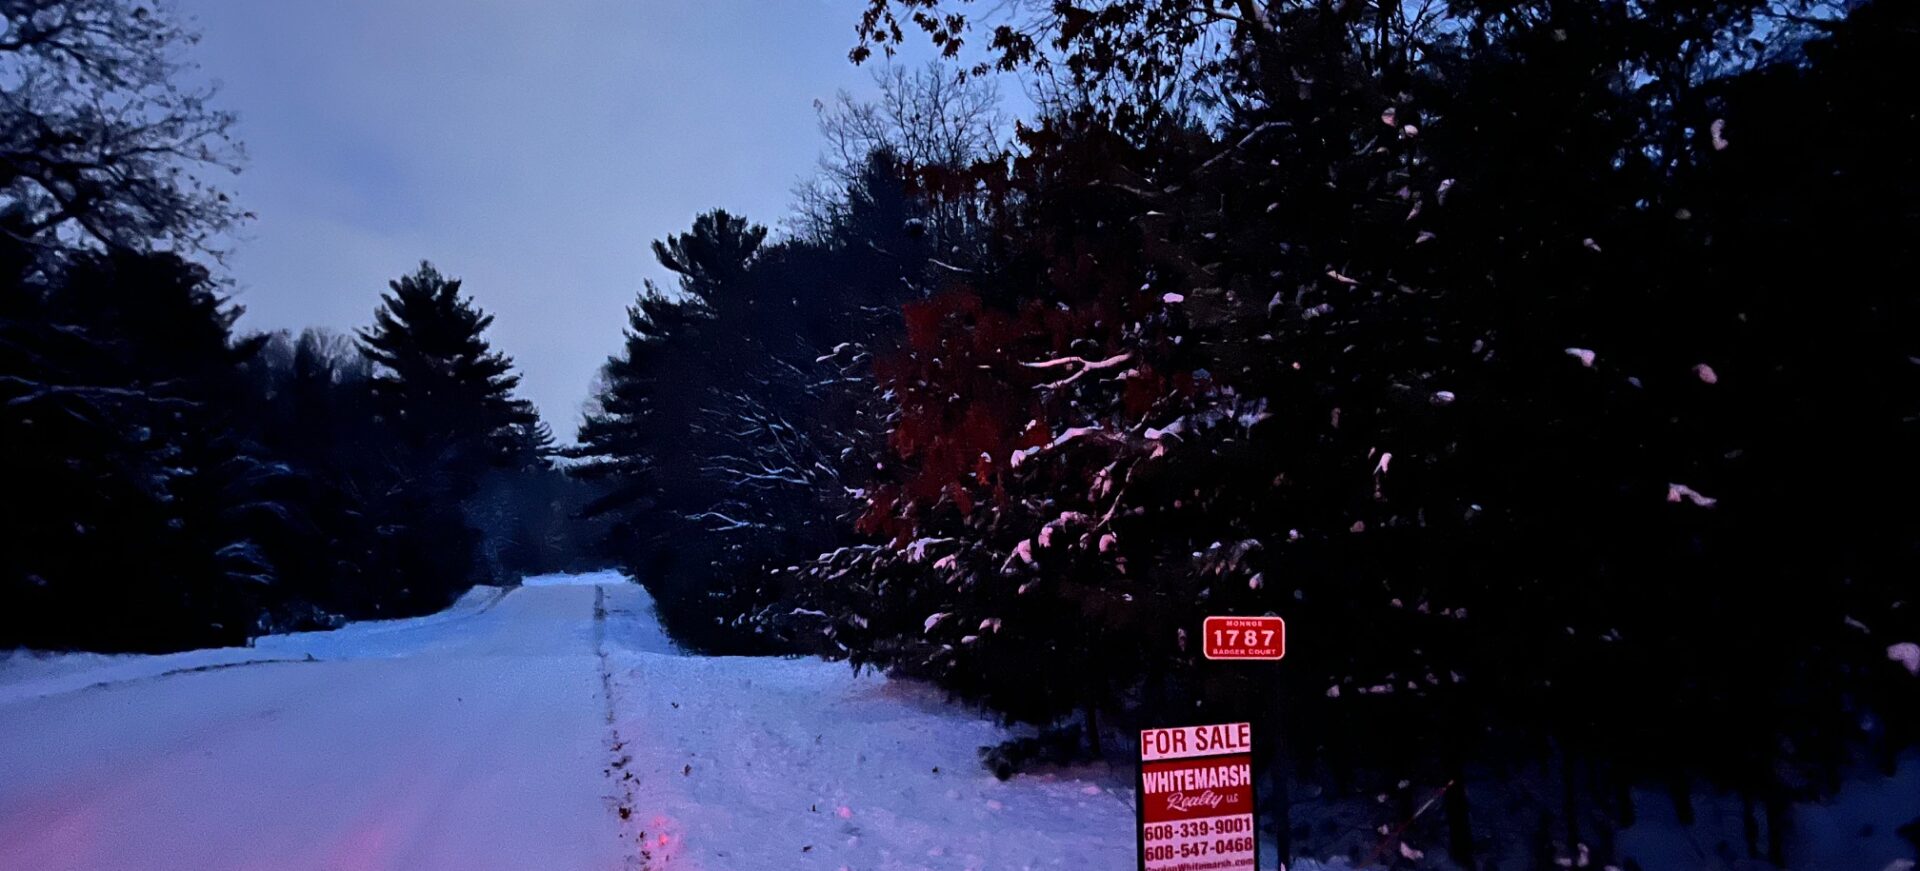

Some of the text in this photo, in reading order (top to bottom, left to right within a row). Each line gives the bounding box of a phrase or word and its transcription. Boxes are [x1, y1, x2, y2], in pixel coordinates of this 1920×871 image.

[1214, 629, 1274, 646] 1787
[1142, 724, 1249, 755] FOR SALE
[1142, 764, 1250, 794] WHITEMARSH
[1167, 790, 1223, 812] Realty
[1145, 818, 1251, 841] 608-339-9001
[1145, 837, 1253, 862] 608-547-0468
